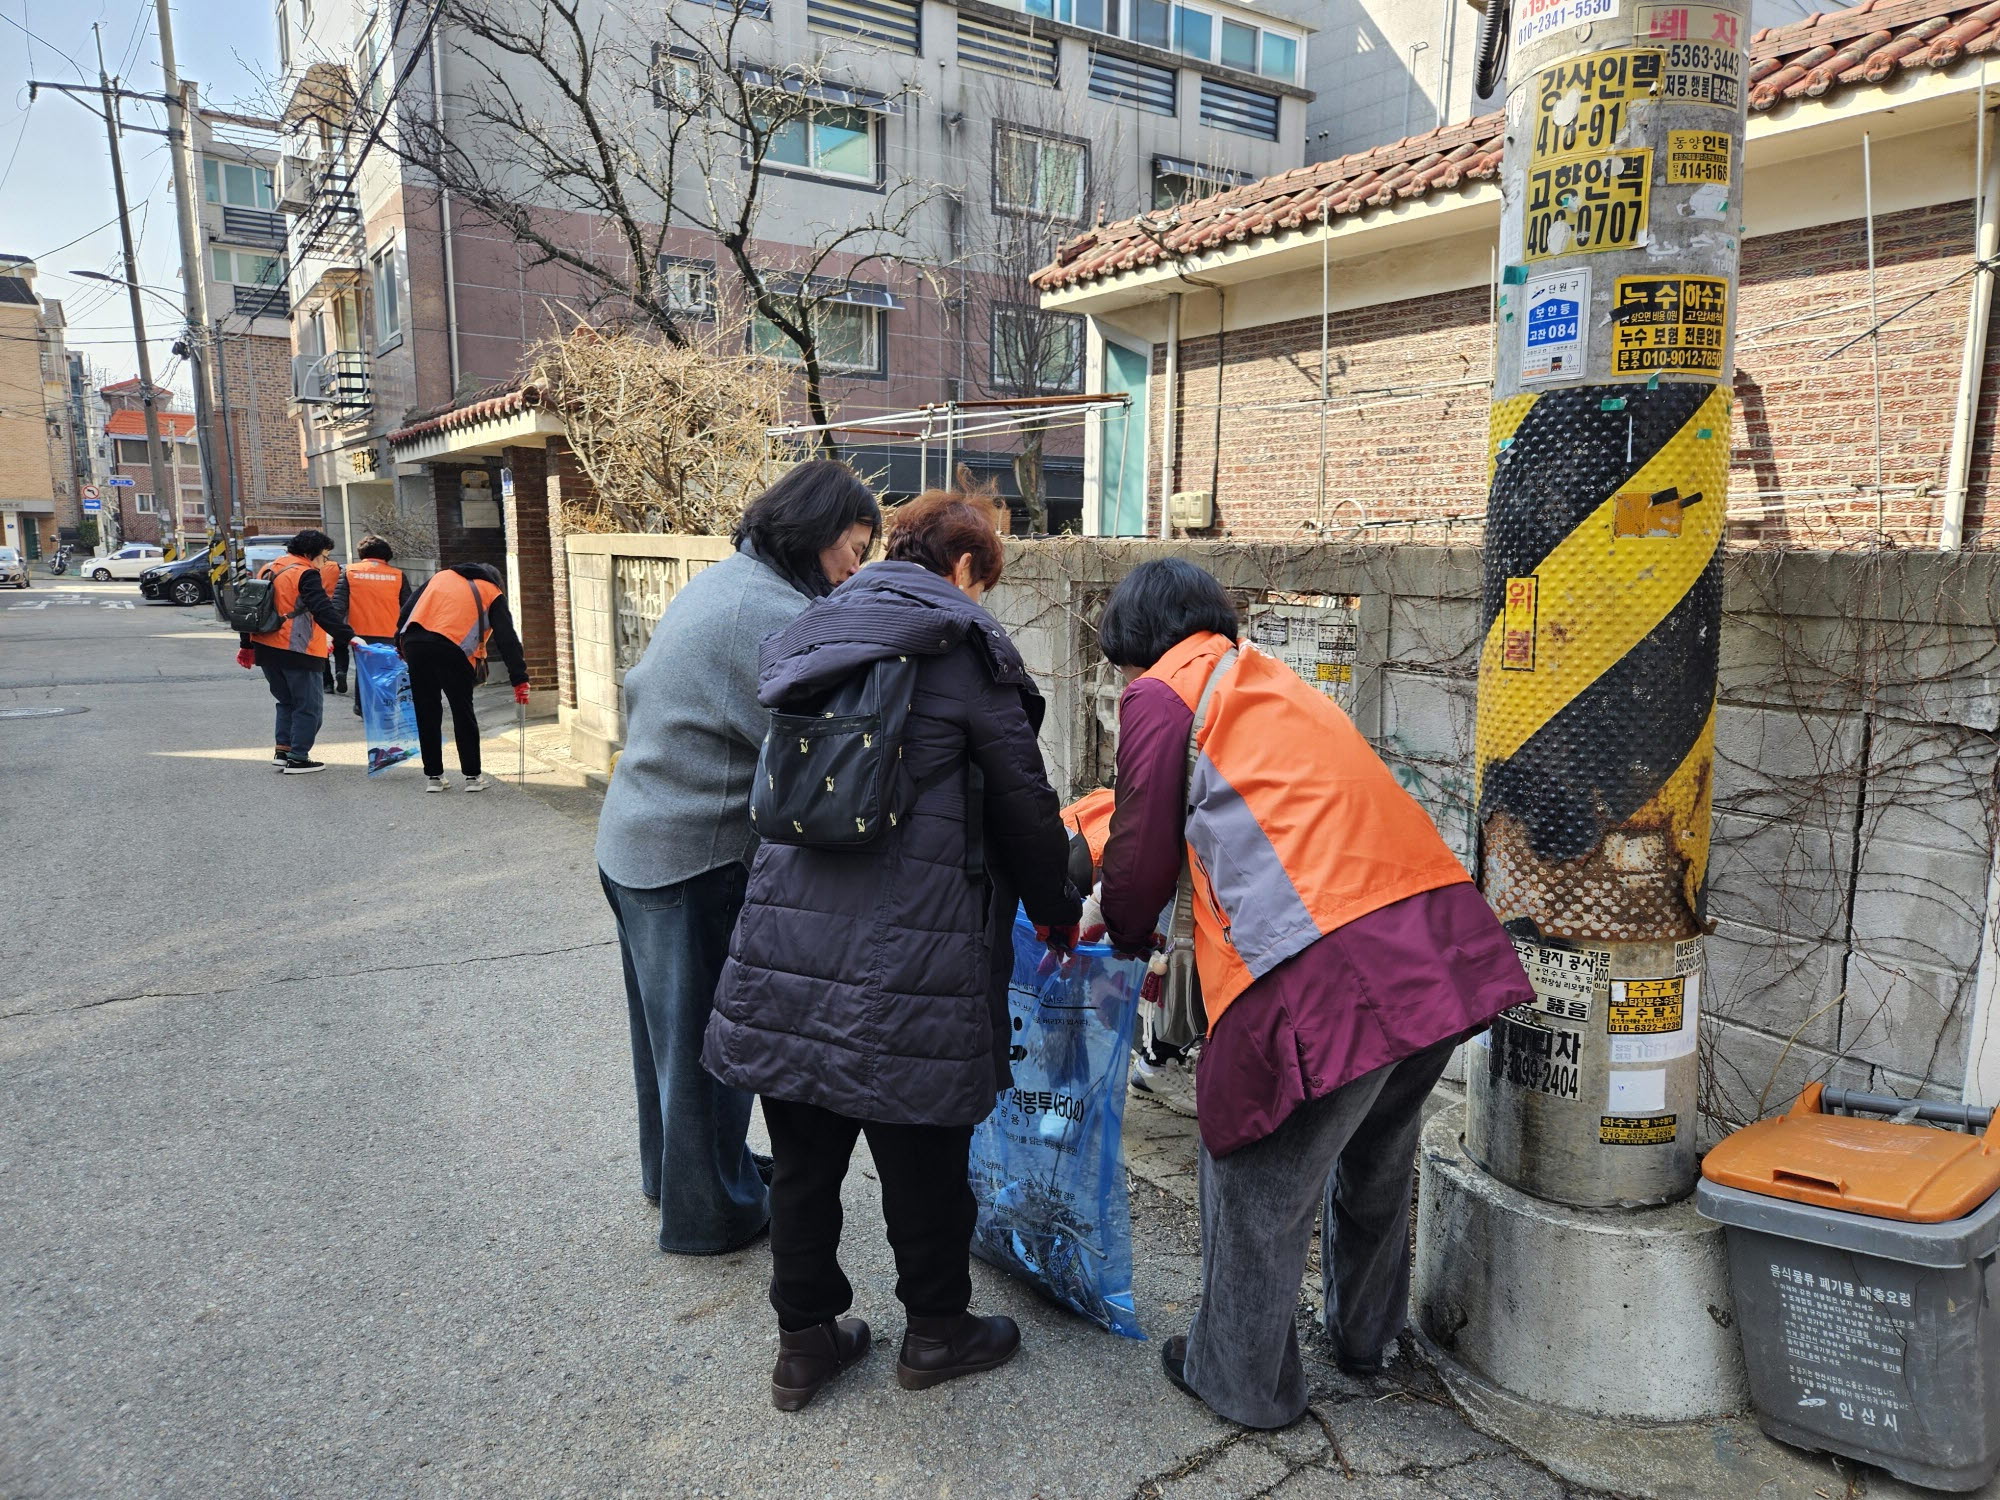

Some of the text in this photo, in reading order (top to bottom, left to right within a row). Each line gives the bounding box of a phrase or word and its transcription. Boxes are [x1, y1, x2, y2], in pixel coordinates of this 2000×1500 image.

[1548, 280, 1579, 295] 단원구
[1685, 284, 1725, 311] 하수구
[1536, 303, 1570, 319] 보안등
[1631, 311, 1652, 323] 찾으면
[1685, 310, 1723, 324] 고압세척
[1529, 322, 1577, 341] 고잔 084
[1620, 328, 1647, 348] 누수
[1654, 326, 1679, 346] 보험
[1620, 361, 1640, 370] 누수
[1505, 583, 1533, 662] 위험
[1539, 949, 1563, 967] 탐지
[1569, 955, 1595, 972] 공사
[1616, 1005, 1679, 1018] 누수탐지
[1610, 1021, 1680, 1032] 010-6322-4239
[1602, 1117, 1650, 1129] 하수구뻥
[1602, 1130, 1672, 1139] 010-6322-4239
[1770, 1264, 1911, 1308] 음식물류 폐기물 배출요령
[1838, 1402, 1898, 1432] 안산시
